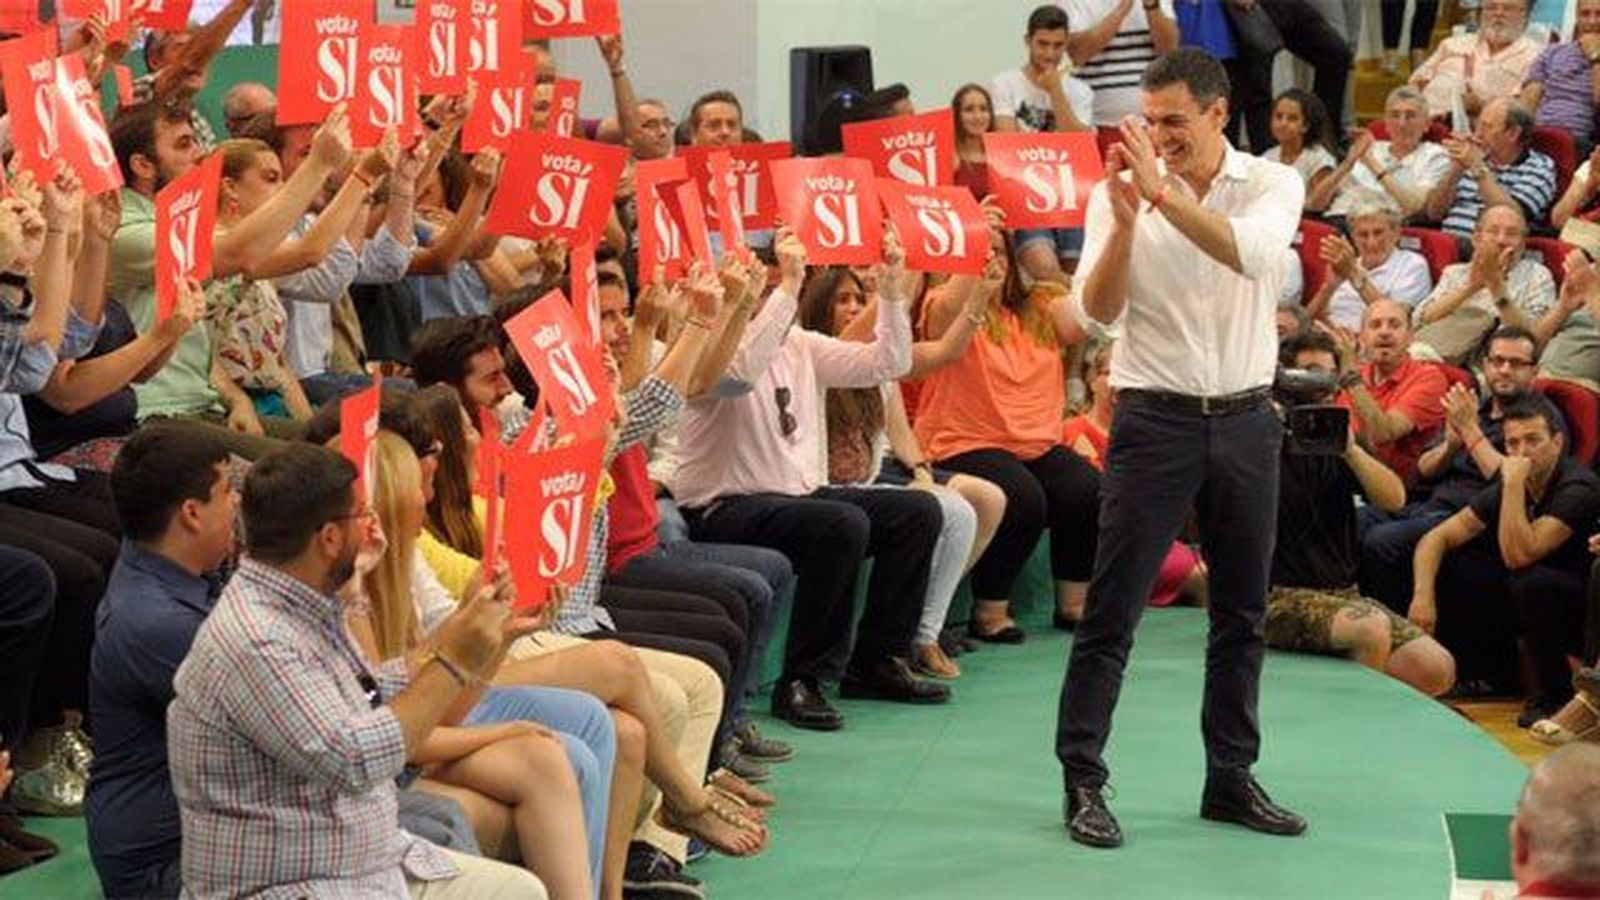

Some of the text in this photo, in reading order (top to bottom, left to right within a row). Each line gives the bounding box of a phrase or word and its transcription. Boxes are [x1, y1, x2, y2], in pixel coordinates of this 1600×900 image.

[881, 131, 926, 149] vota
[541, 152, 581, 175] vota
[1017, 147, 1057, 162] vota
[804, 175, 845, 191] vota
[541, 475, 578, 497] vota
